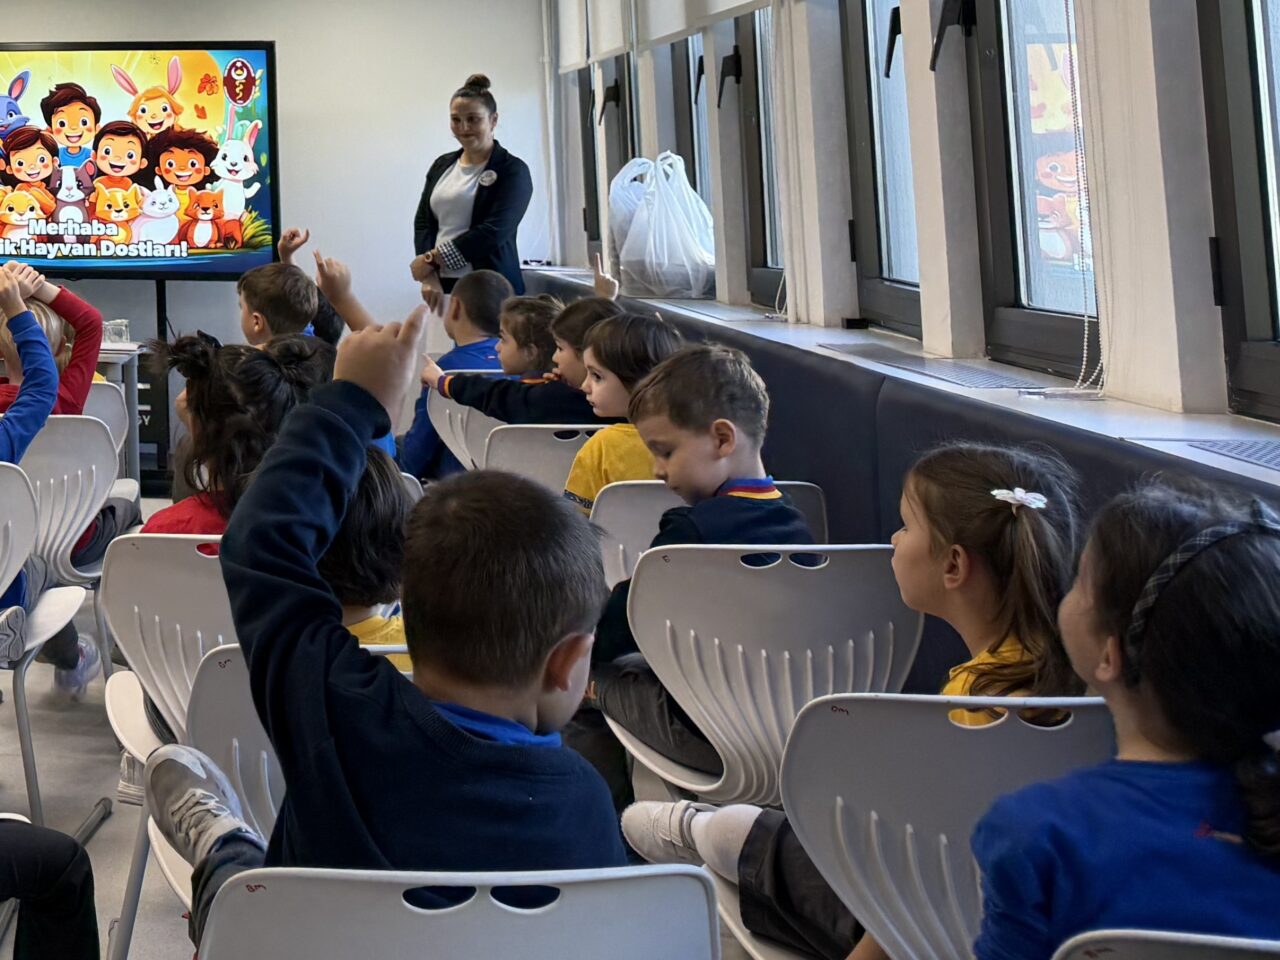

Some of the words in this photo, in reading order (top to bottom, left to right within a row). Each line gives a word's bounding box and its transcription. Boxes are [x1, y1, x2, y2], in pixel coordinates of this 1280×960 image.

[28, 218, 118, 236] Merhaba
[19, 238, 97, 259] Hayvan
[100, 239, 188, 258] Dostları!
